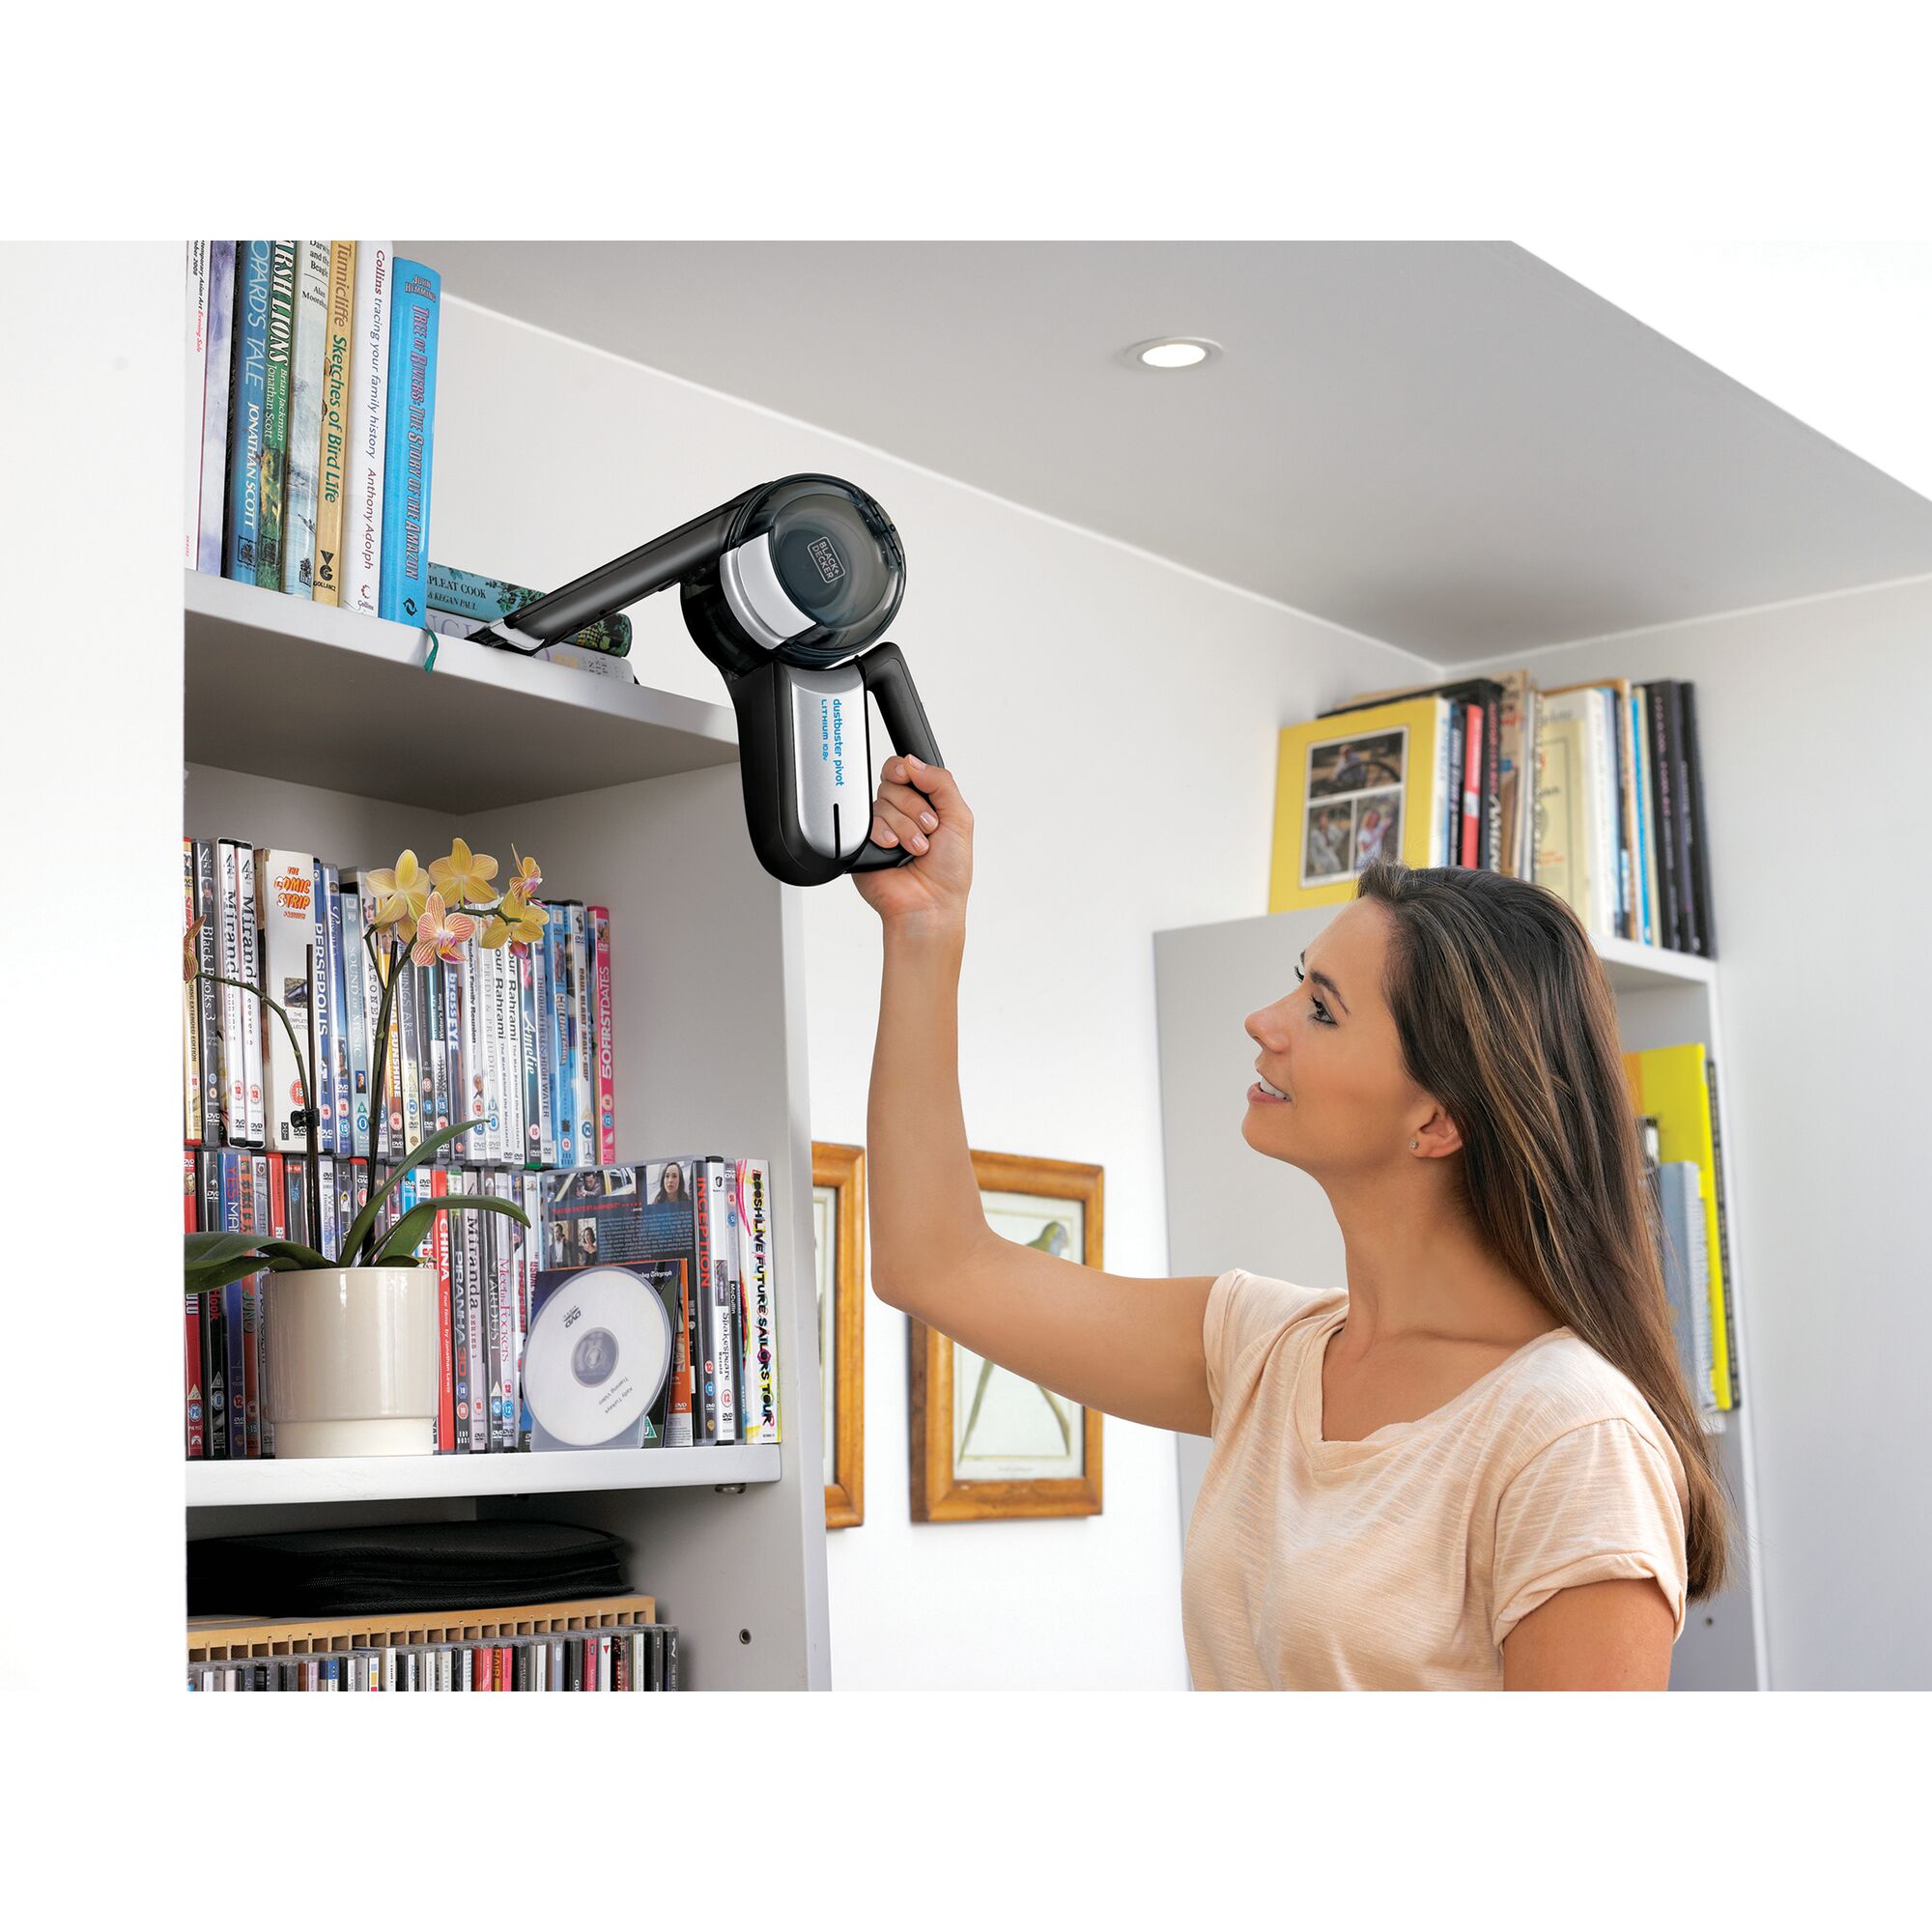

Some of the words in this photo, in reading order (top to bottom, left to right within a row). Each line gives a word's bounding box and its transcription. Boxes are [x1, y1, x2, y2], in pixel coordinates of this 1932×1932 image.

[310, 250, 322, 262] and
[374, 250, 385, 295] Collins
[334, 243, 352, 327] Tunnicliffe
[405, 281, 437, 303] HEMMING
[270, 298, 292, 366] LIONS
[370, 298, 383, 341] tracing
[412, 304, 430, 342] TREE
[245, 336, 266, 390] TALE
[329, 334, 347, 408] Sketches
[369, 342, 381, 373] your
[266, 363, 277, 412] Jonathan
[279, 368, 288, 396] Brian
[367, 373, 381, 414] family
[246, 402, 260, 478] JONATHAN
[264, 412, 275, 439] Scott
[276, 396, 287, 441] Jackman
[328, 411, 343, 433] of
[365, 414, 380, 459] history
[409, 405, 425, 432] THE
[326, 435, 342, 471] Bird
[407, 432, 425, 477] STORY
[244, 480, 257, 530] SCOTT
[325, 473, 340, 503] Life
[362, 468, 377, 523] Anthony
[406, 495, 421, 523] THE
[407, 482, 422, 495] OF
[361, 524, 375, 570] Adolph
[404, 522, 422, 581] AMAZON
[810, 545, 835, 581] DECKER
[427, 576, 459, 592] PLEAT
[461, 584, 487, 599] COOK
[434, 593, 459, 606] KEGAN
[460, 598, 477, 611] PAUL
[833, 698, 843, 757] dustbuster
[833, 759, 844, 787] pivot
[273, 875, 311, 895] COMIC
[287, 866, 299, 875] THE
[277, 893, 310, 910] STRIP
[202, 925, 214, 962] Black
[495, 949, 503, 973] our
[203, 966, 215, 1009] Books
[314, 923, 327, 1036] PERSEPOLIS
[348, 946, 358, 994] SOUND
[537, 977, 546, 1022] THROUGH
[352, 1013, 362, 1058] MUSIC
[404, 1011, 413, 1037] ARE
[390, 1031, 401, 1097] SUNSHINE
[540, 1056, 549, 1080] HIGH
[227, 1165, 238, 1199] YES
[440, 1218, 450, 1282] CHINA
[696, 1177, 711, 1288] INCEPTION
[753, 1218, 766, 1253] LIVE
[468, 1216, 480, 1310] Miranda
[186, 1293, 199, 1315] ULU
[210, 1289, 222, 1321] Hook
[455, 1251, 466, 1345] PIRANHA
[756, 1255, 768, 1315] FUTURE
[242, 1290, 257, 1333] JUNO
[443, 1329, 450, 1338] by
[500, 1305, 511, 1362] Fockers
[722, 1312, 730, 1381] Shakespeare
[756, 1318, 772, 1380] SAILORS
[457, 1346, 467, 1376] 3D
[760, 1383, 775, 1427] TOUR
[493, 1648, 501, 1678] HAIR
